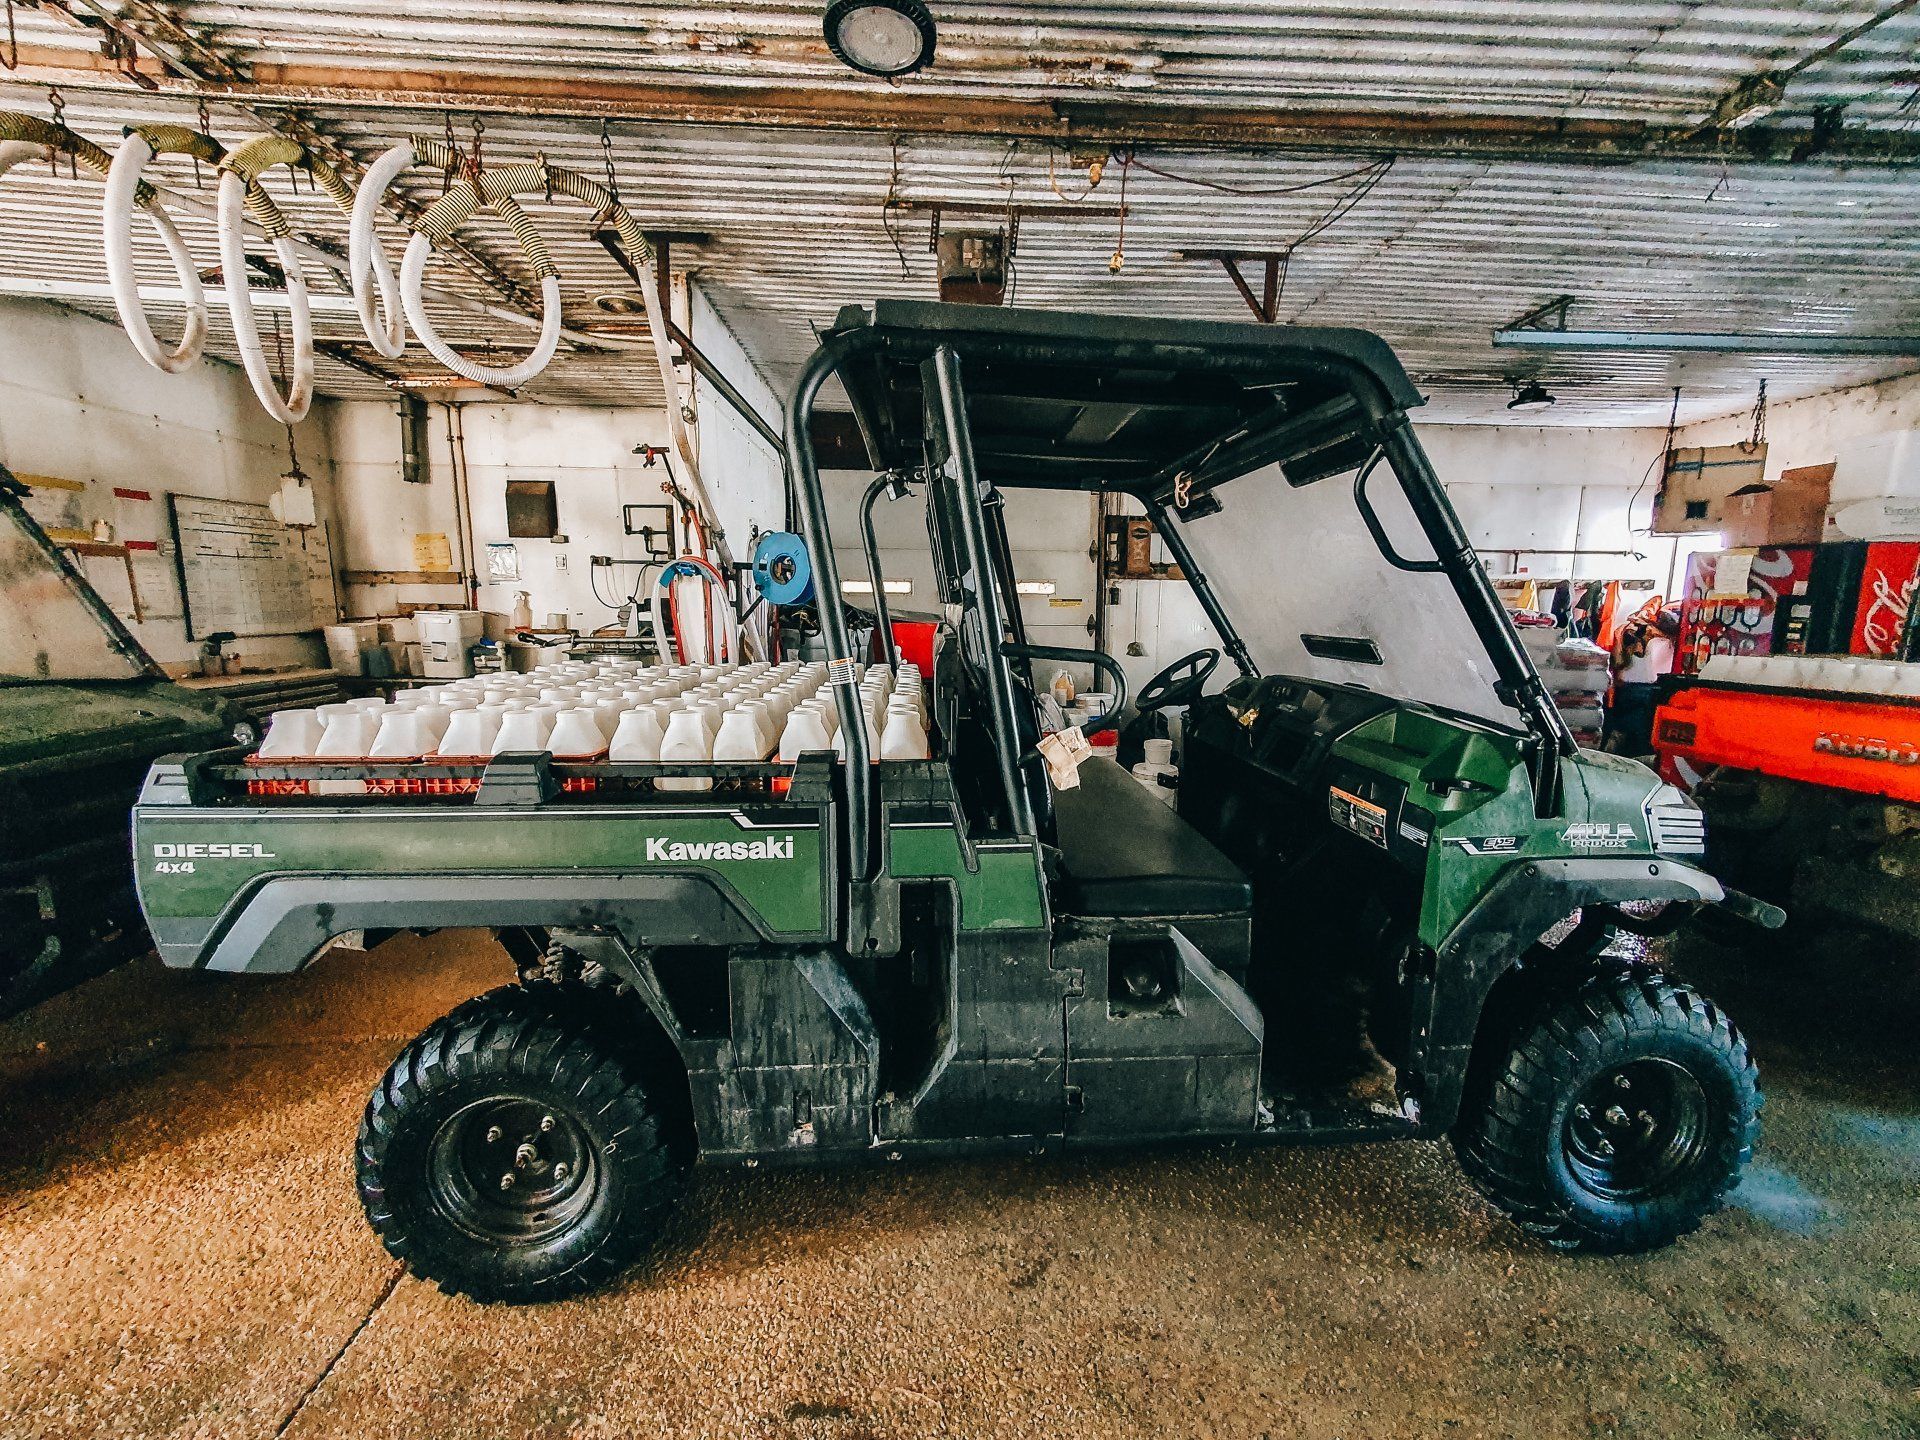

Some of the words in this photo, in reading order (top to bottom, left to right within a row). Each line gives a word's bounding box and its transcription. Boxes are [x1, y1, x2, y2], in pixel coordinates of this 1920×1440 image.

[1560, 823, 1637, 840] MULE
[646, 836, 793, 860] Kawasaki
[1483, 836, 1516, 849] EPS
[153, 843, 276, 857] DIESEL
[155, 861, 196, 873] 4x4
